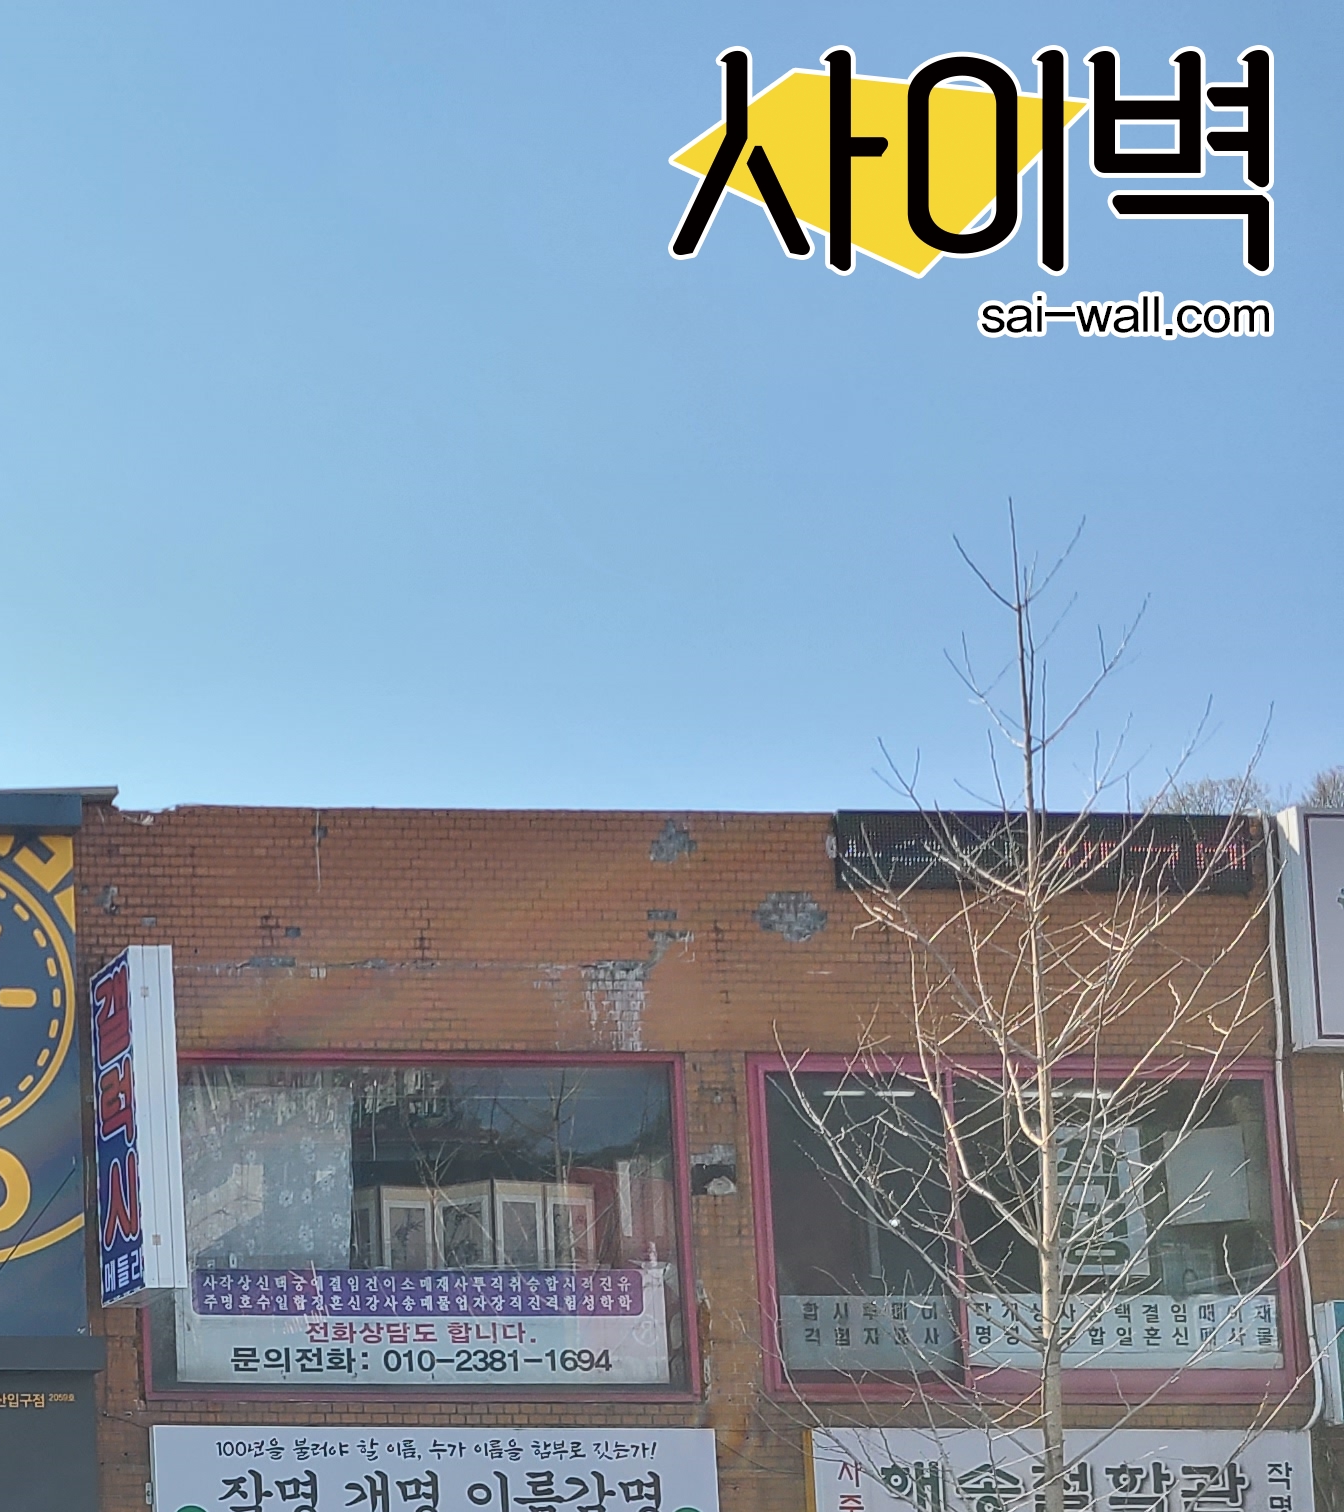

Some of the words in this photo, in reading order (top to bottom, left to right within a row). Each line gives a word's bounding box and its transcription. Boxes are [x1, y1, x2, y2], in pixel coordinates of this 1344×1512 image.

[305, 1321, 439, 1344] 전화상담도
[447, 1321, 537, 1344] 합니다.
[230, 1347, 369, 1374] 문의전화:
[383, 1349, 613, 1373] 010-2381-1694
[215, 1438, 285, 1460] 100년을
[293, 1438, 349, 1461] 불러야
[356, 1438, 379, 1461] 할
[429, 1440, 466, 1460] 누가
[474, 1438, 524, 1461] 이름을
[530, 1440, 586, 1460] 함부로
[593, 1441, 657, 1460] 짓는가!
